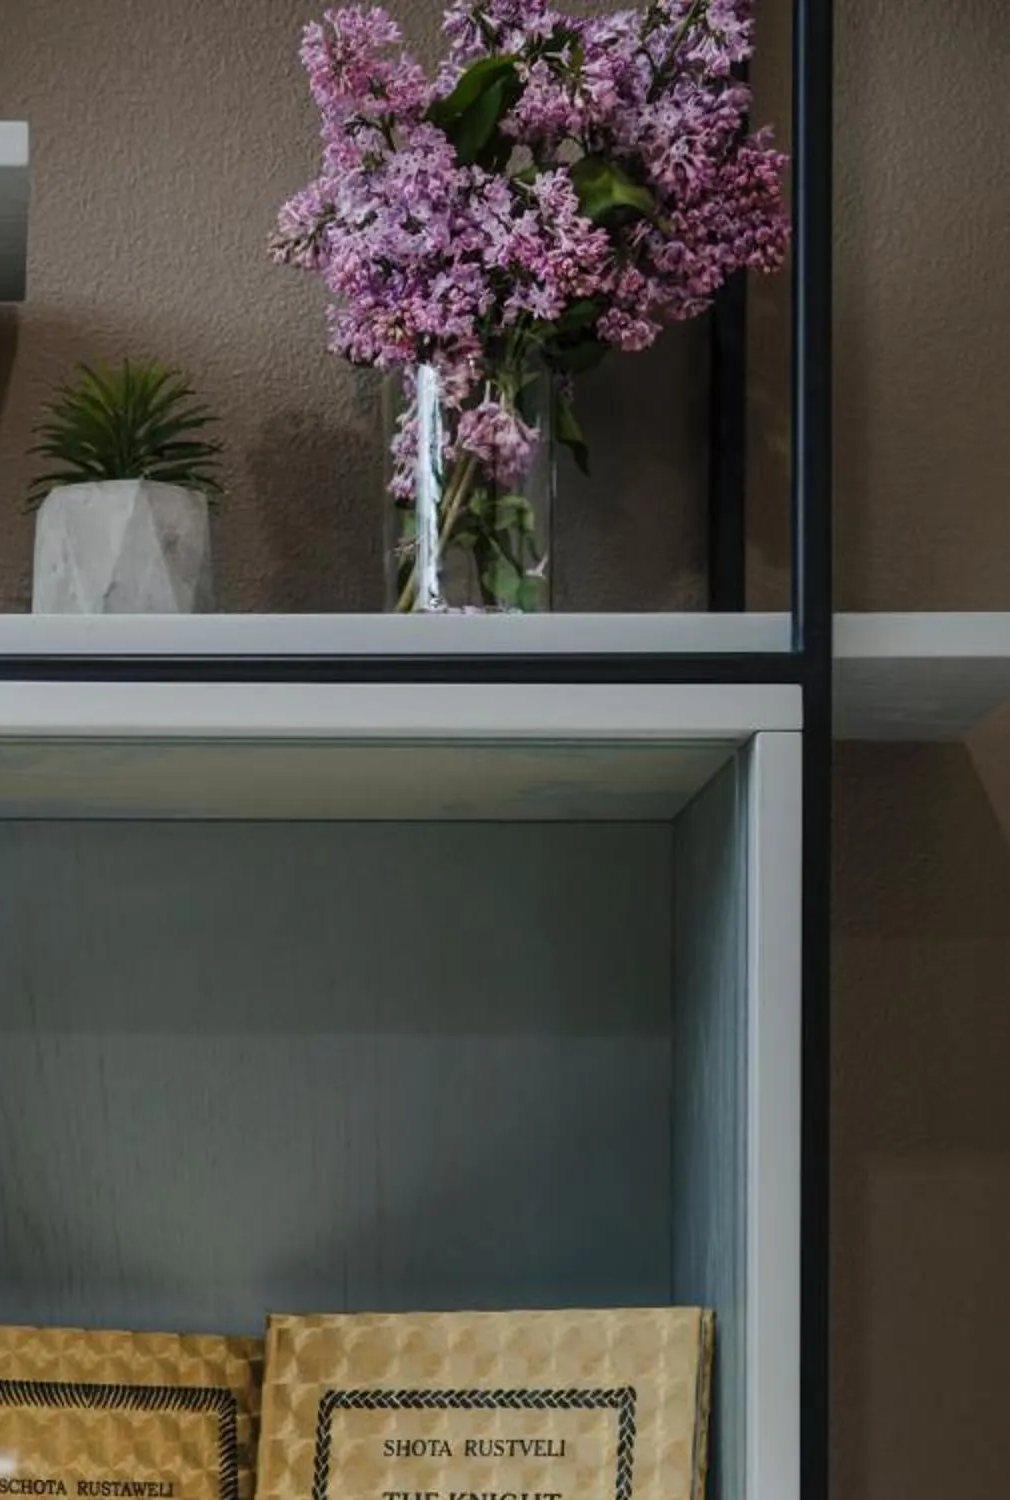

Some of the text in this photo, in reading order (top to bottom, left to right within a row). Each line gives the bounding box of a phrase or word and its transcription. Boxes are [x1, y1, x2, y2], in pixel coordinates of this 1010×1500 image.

[382, 1438, 566, 1458] SHOTA RUSTVELI
[77, 1480, 175, 1498] RUSTAWELI
